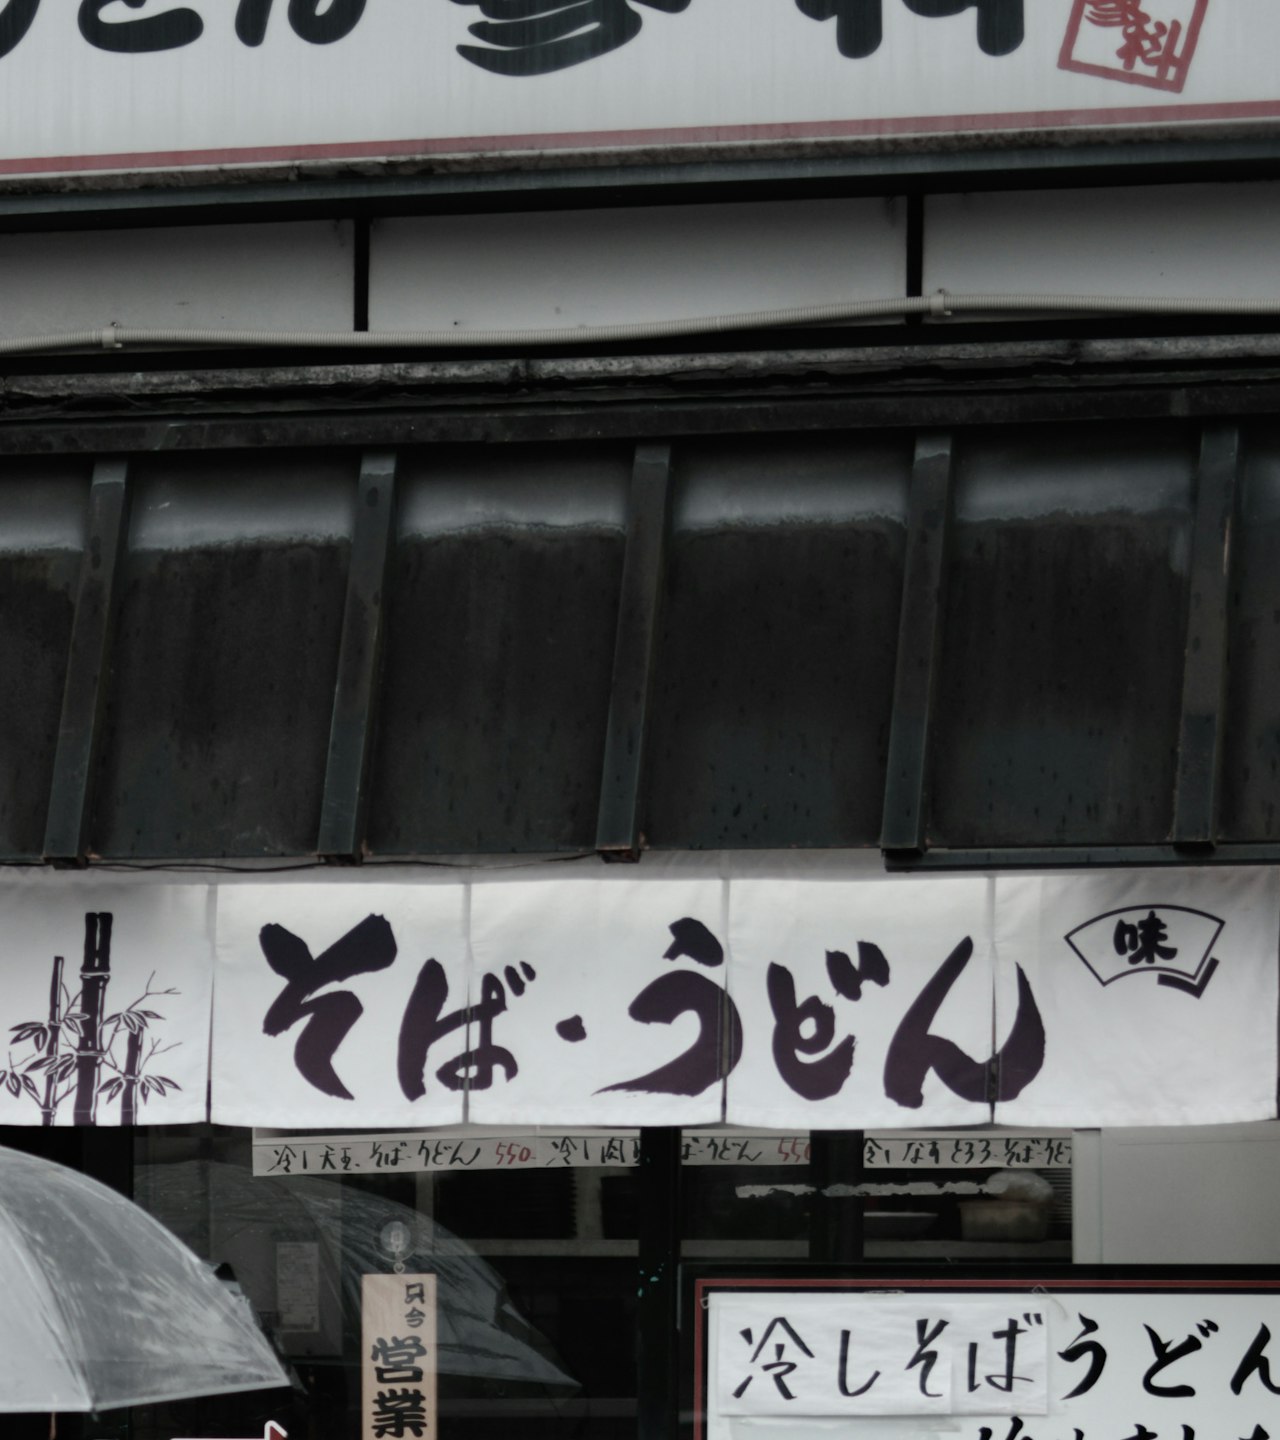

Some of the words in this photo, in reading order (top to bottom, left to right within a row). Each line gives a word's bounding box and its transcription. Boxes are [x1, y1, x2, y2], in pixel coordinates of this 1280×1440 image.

[1113, 910, 1178, 965] 味
[260, 912, 1046, 1108] そば・うどん
